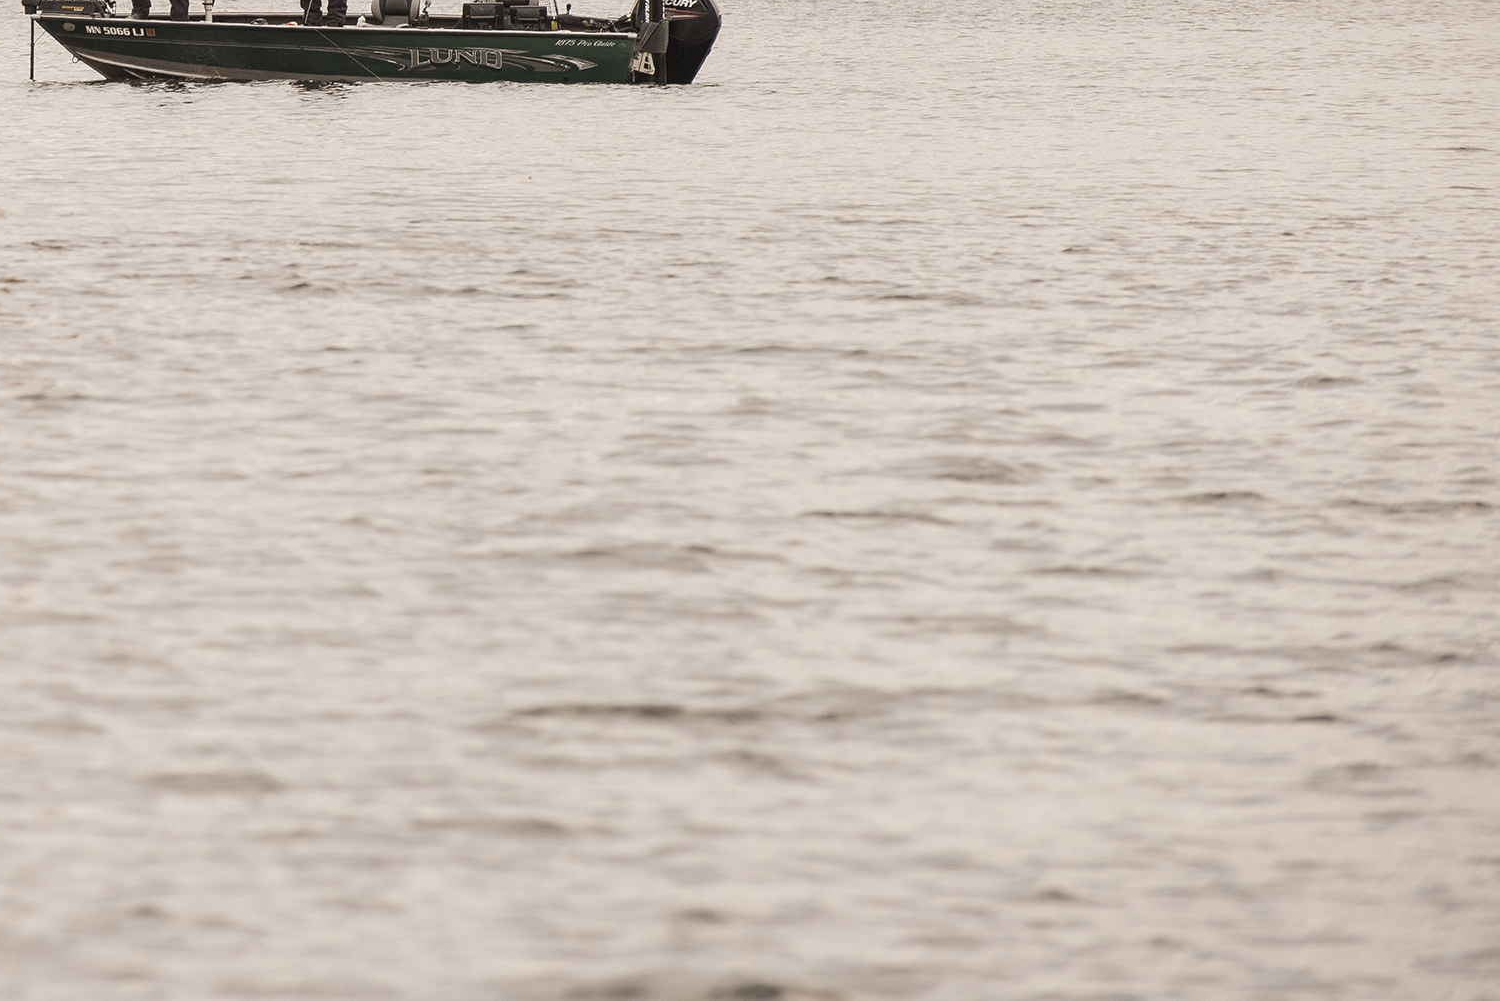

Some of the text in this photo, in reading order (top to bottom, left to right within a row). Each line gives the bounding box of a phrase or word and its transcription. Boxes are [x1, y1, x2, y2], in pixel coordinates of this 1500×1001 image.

[85, 25, 145, 37] MN 5066 LJ
[410, 49, 502, 69] LUND
